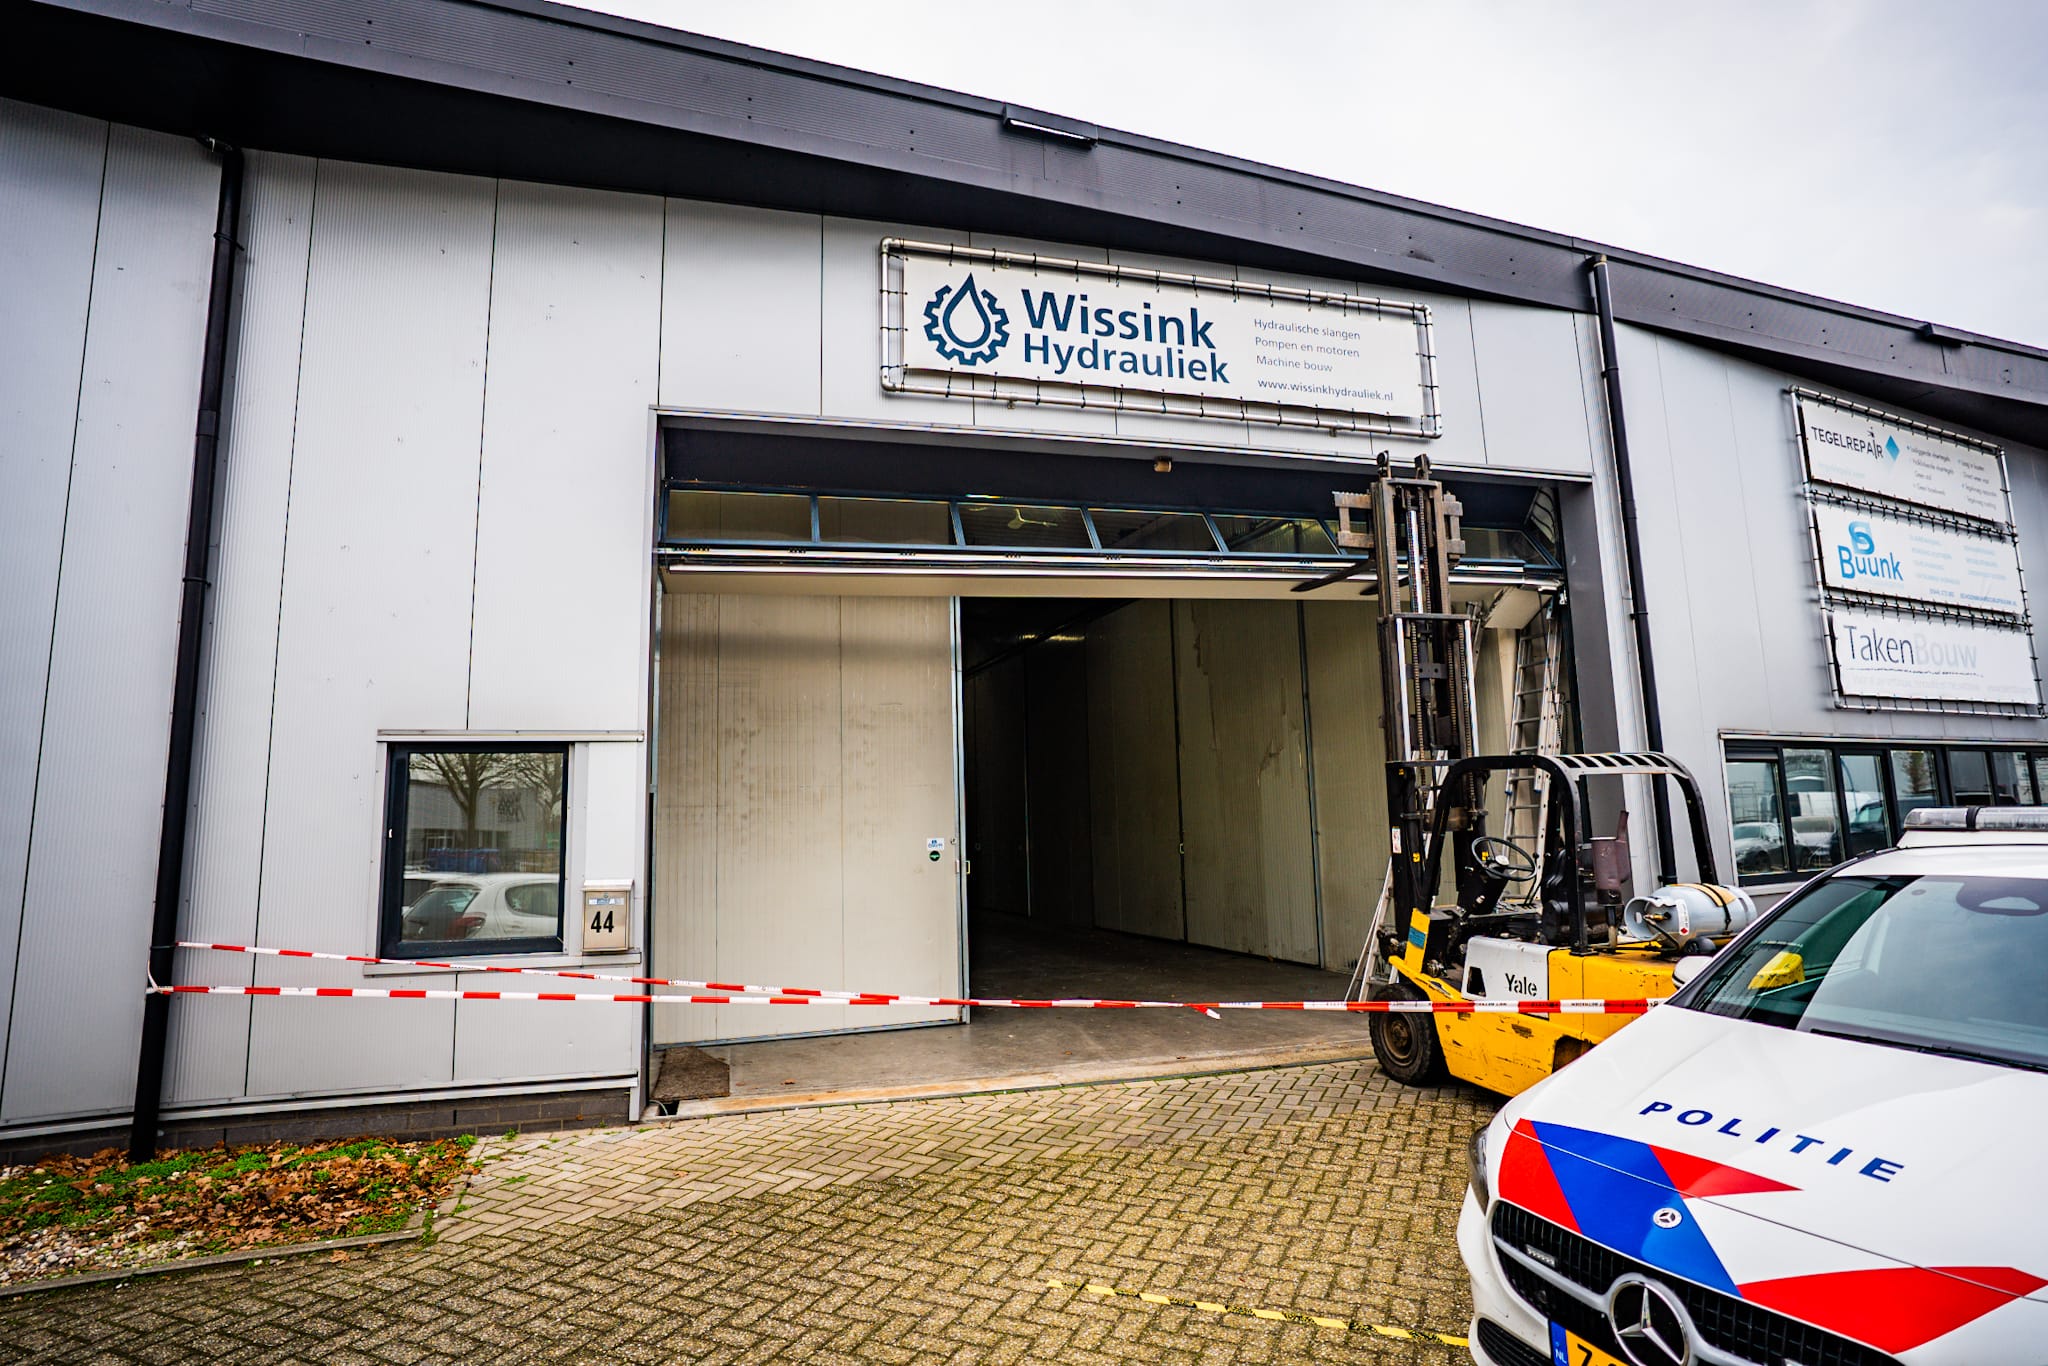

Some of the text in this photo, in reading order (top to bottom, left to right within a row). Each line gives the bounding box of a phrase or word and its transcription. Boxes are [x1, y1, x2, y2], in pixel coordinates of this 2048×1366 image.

[1021, 289, 1216, 349] Wissink
[1254, 318, 1361, 341] Hydraulische slangen
[1024, 333, 1230, 384] Hydrauliek
[1255, 336, 1360, 358] Pompen en motoren
[1256, 355, 1333, 372] Machine bouw
[1258, 379, 1394, 401] www.wissinkhydrauliek.nl
[1811, 426, 1884, 460] TEGELREPAIR
[1838, 545, 1904, 581] Buunk
[1843, 625, 1977, 669] TakenBouw
[591, 910, 614, 933] 44
[1505, 973, 1537, 997] Yale
[1638, 1101, 1905, 1183] POLITIE
[1555, 1348, 1567, 1364] NL
